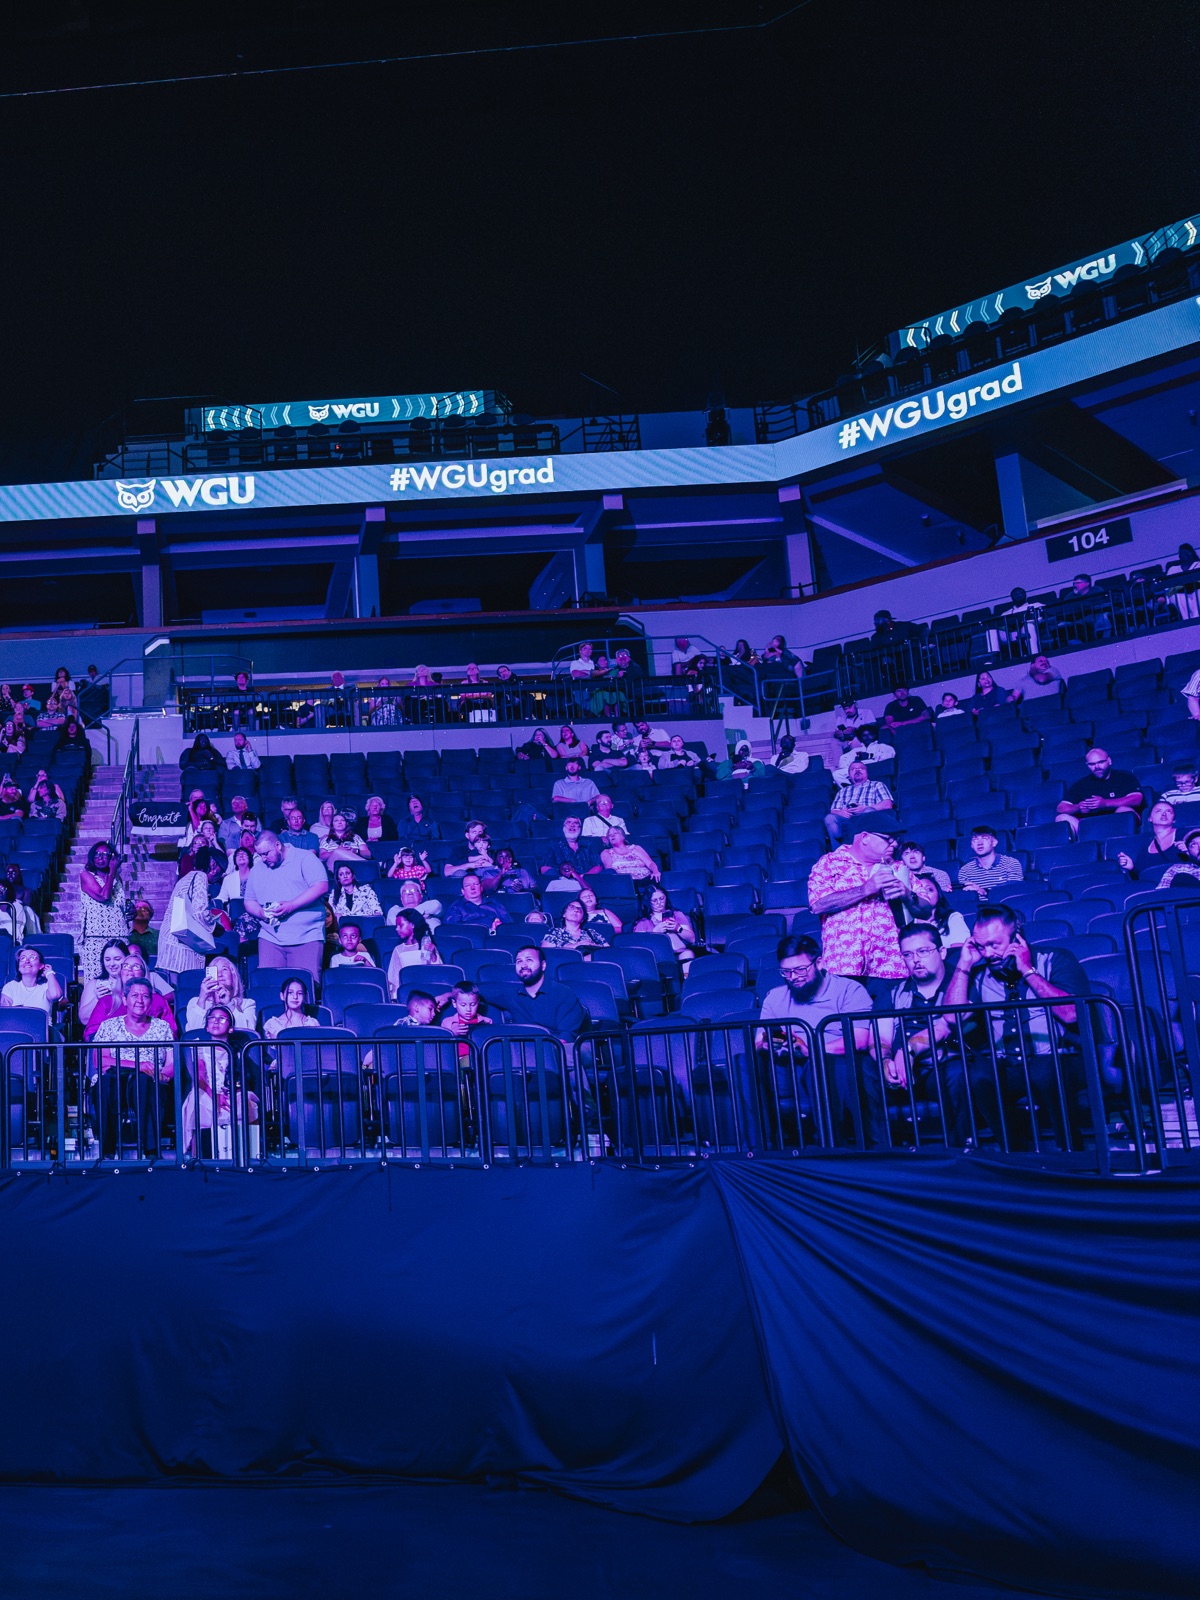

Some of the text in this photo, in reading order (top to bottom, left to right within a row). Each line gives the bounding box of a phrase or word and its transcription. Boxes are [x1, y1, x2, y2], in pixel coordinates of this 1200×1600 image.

[1053, 253, 1117, 292] WGU
[330, 402, 380, 420] WGU
[838, 362, 1023, 450] #WGUgrad
[160, 475, 255, 508] WGU
[389, 457, 555, 493] #WGUgrad
[1068, 527, 1110, 553] 104
